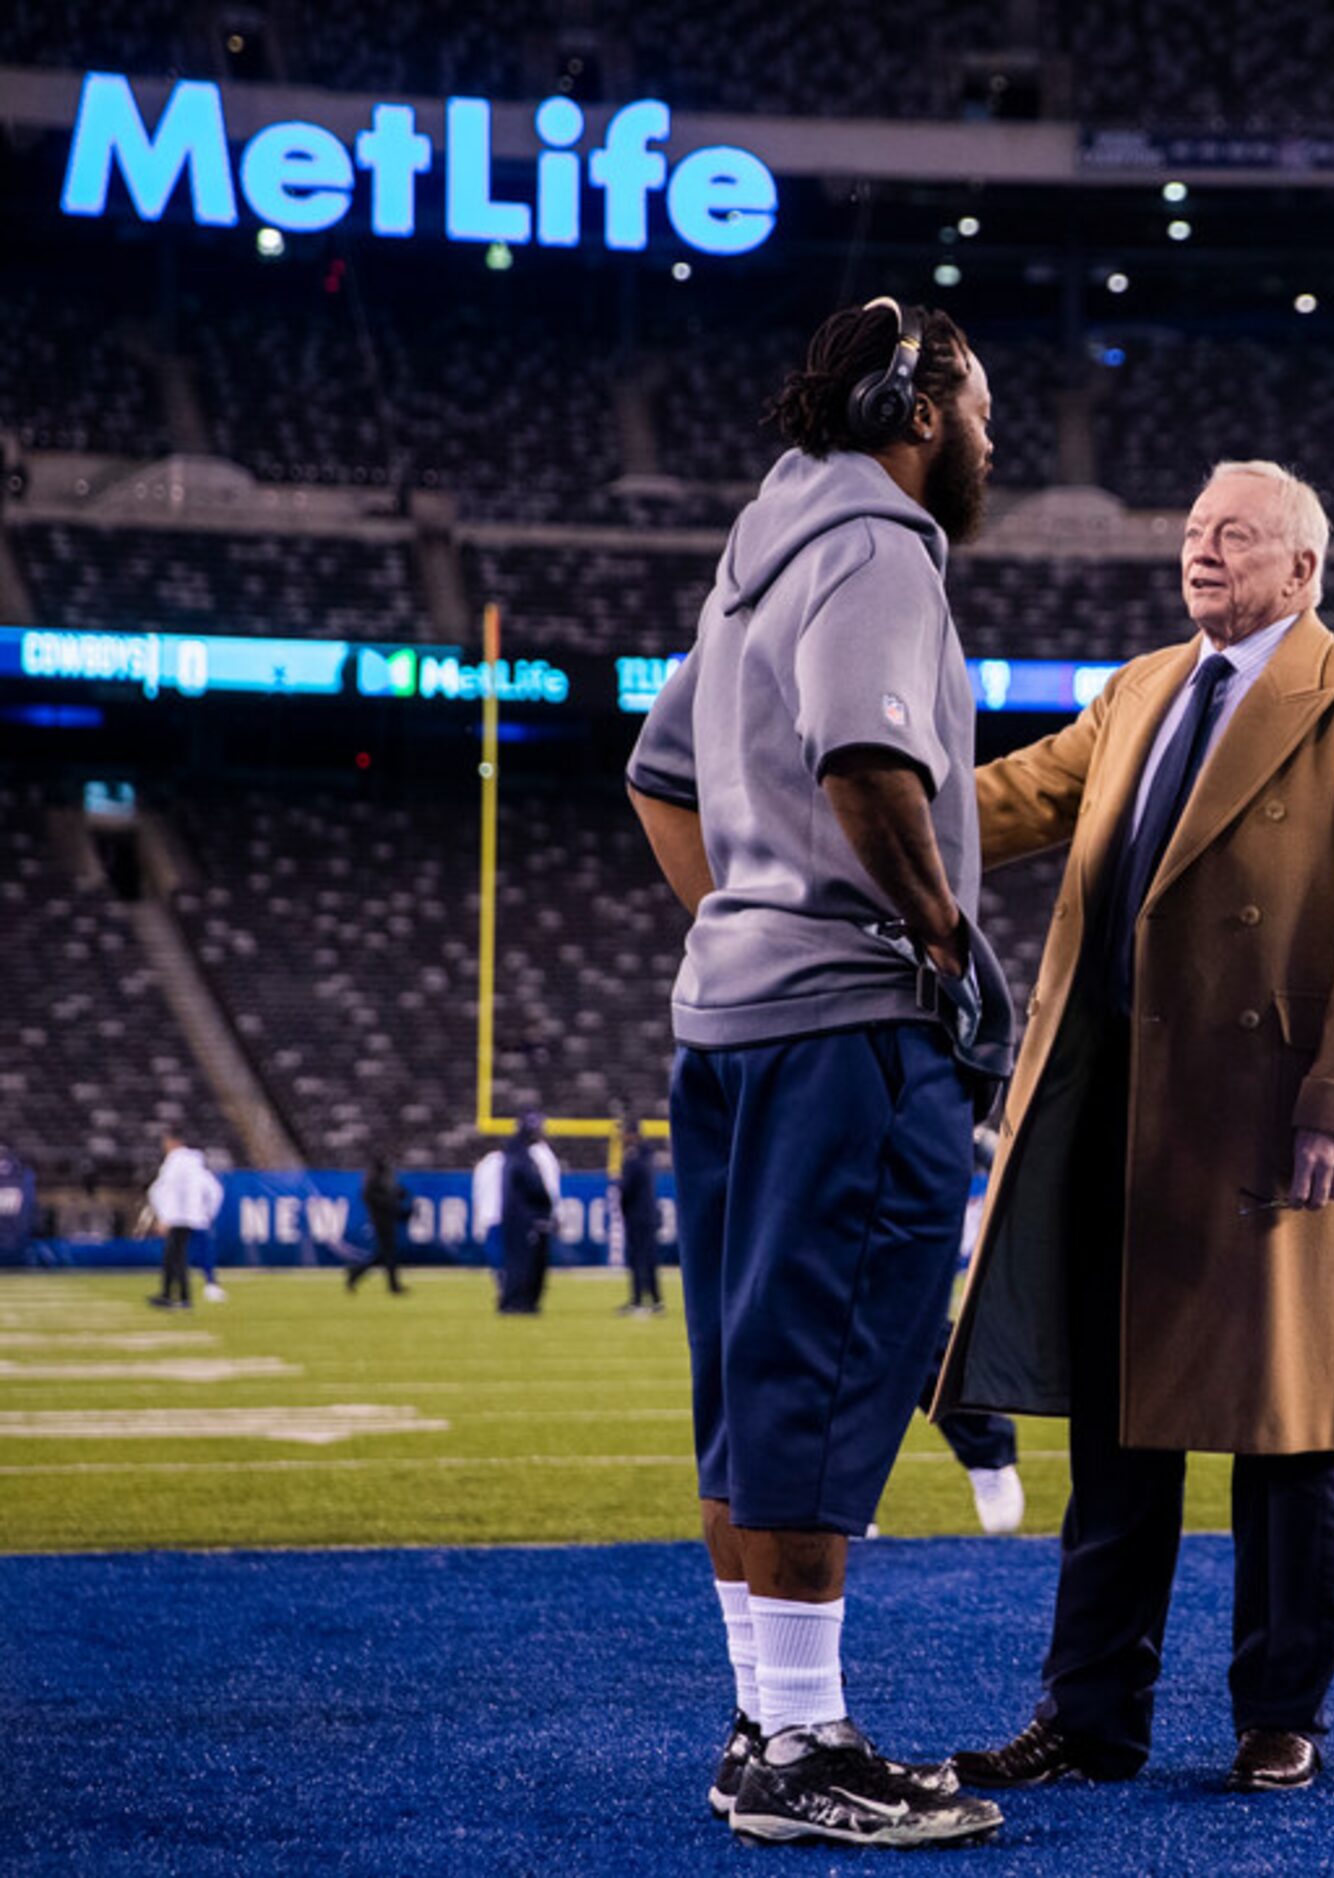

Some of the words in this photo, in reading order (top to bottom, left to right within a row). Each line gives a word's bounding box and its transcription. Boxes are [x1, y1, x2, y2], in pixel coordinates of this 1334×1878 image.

[61, 71, 778, 255] MetLife
[419, 655, 570, 704] MetLife
[240, 1196, 349, 1246] NEW
